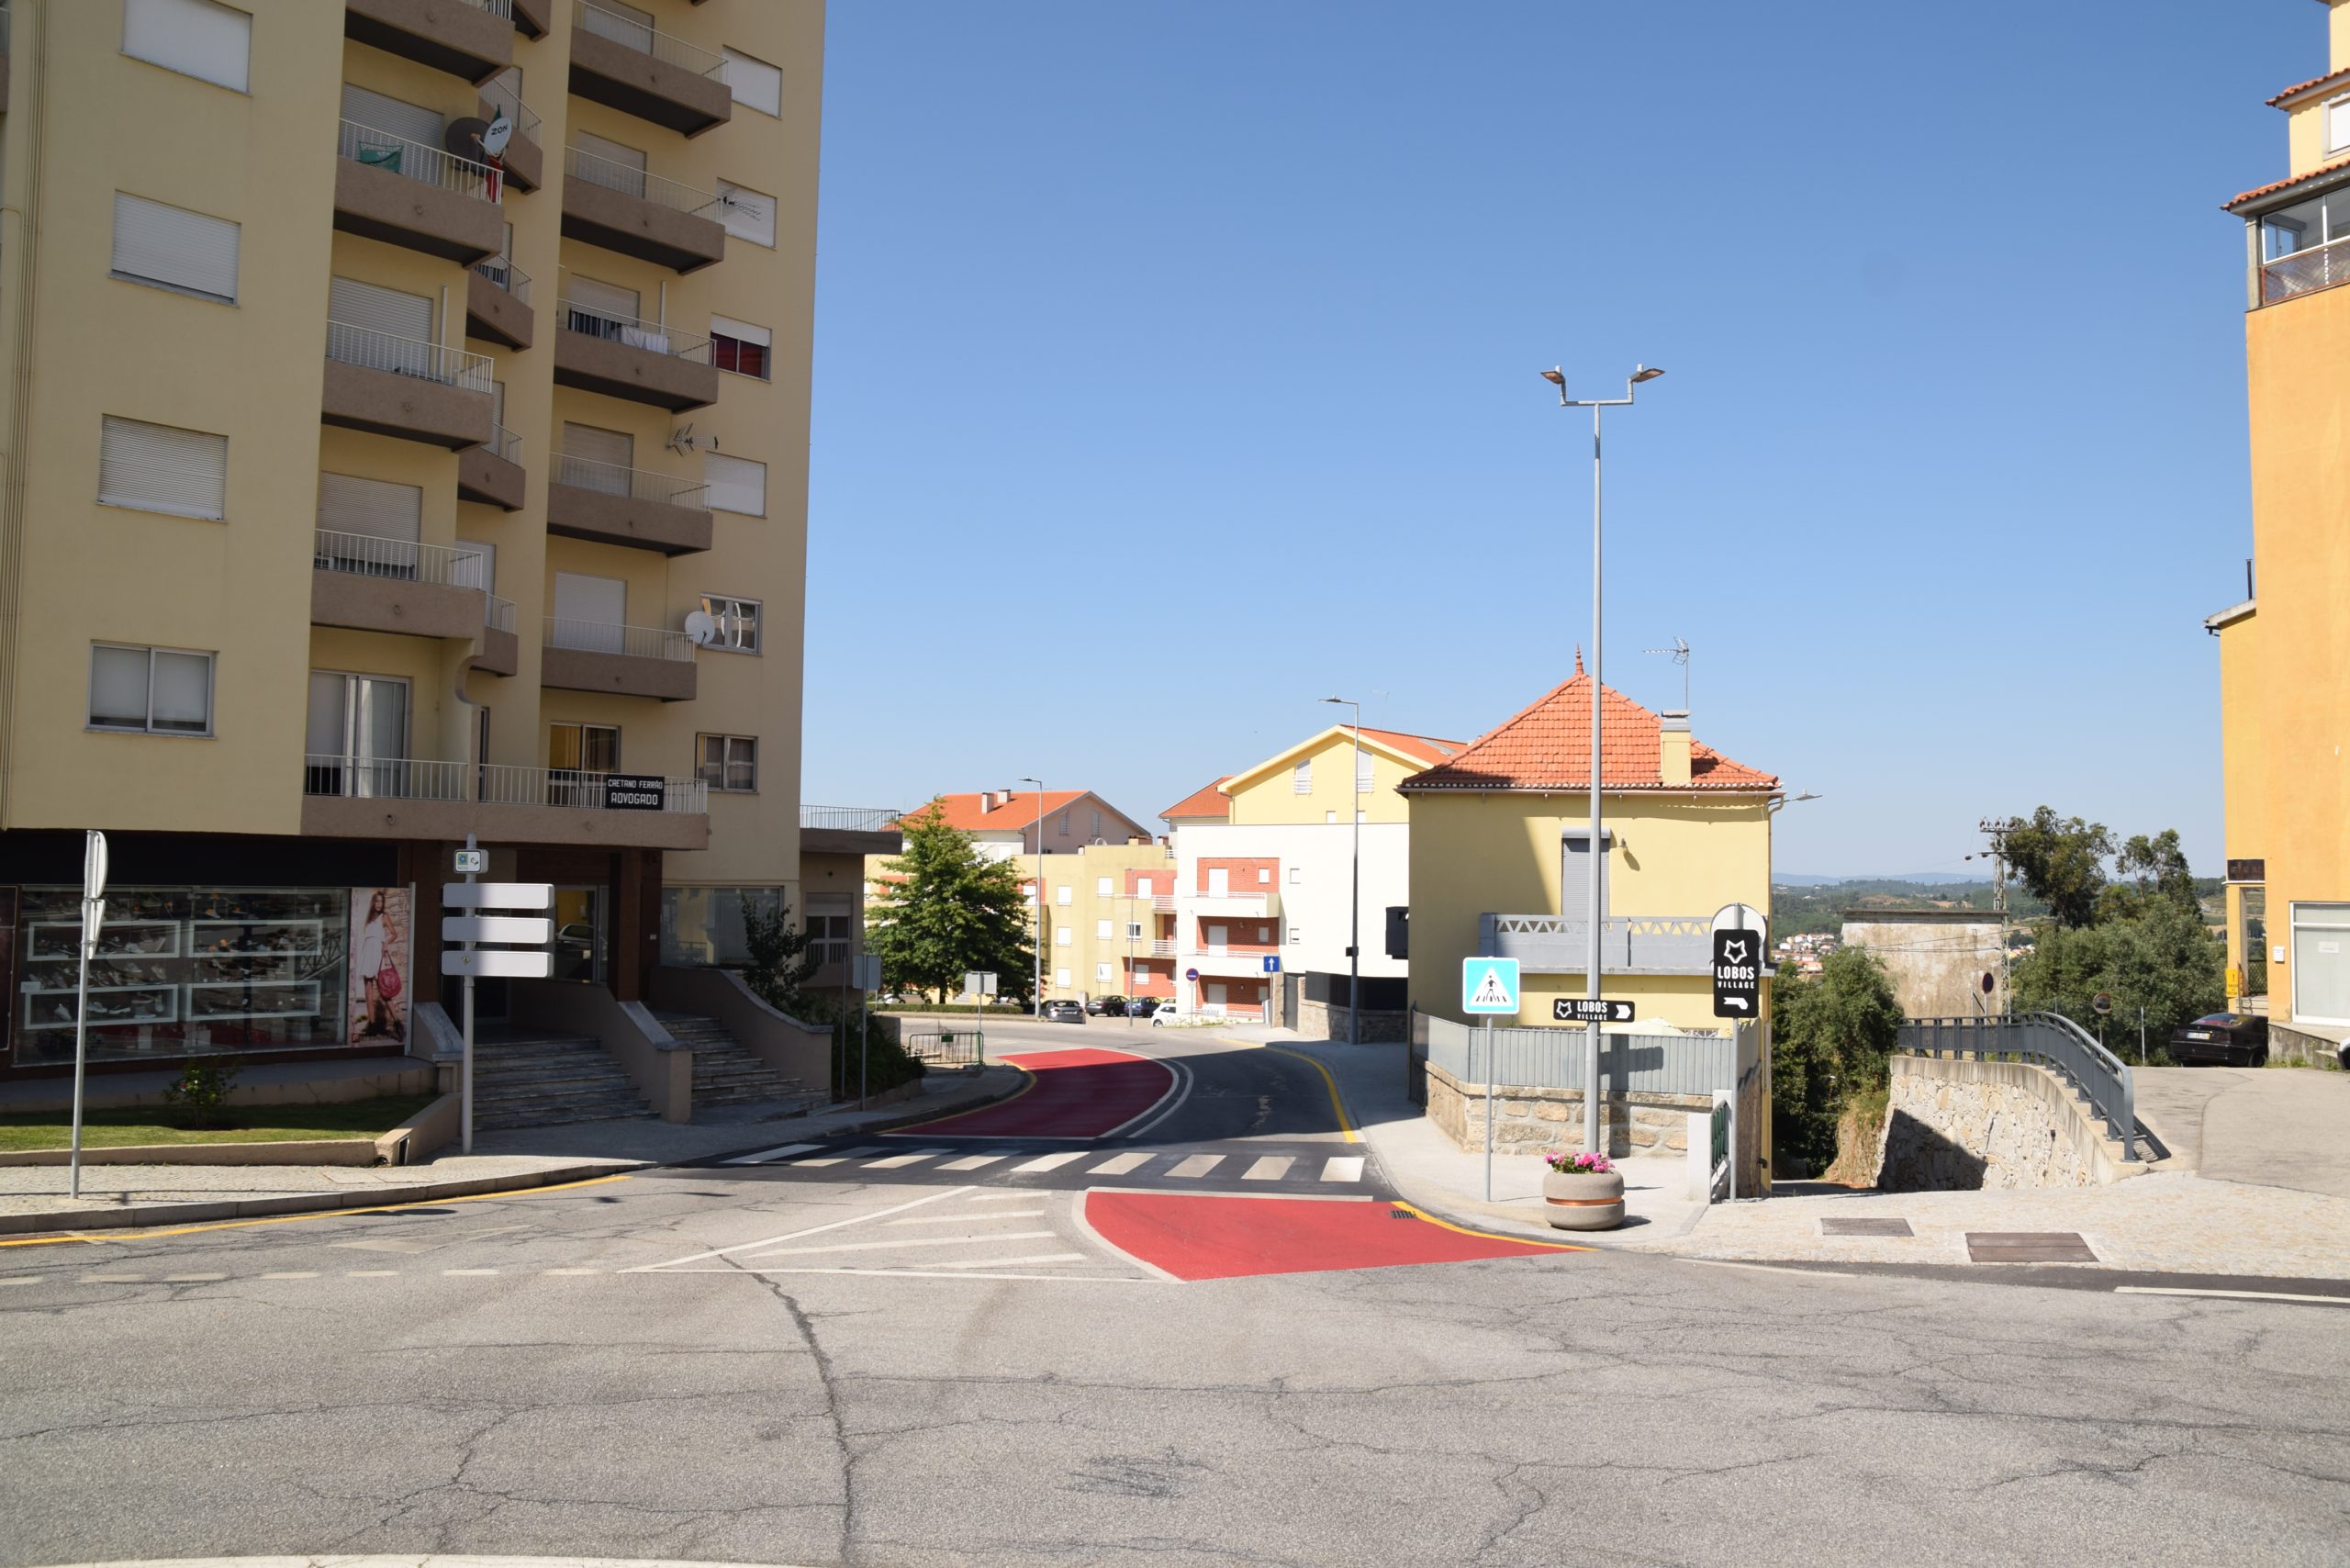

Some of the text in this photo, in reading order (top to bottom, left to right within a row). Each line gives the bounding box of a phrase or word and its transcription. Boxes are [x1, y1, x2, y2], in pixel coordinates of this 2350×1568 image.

[491, 124, 508, 135] ZON
[608, 778, 663, 790] CAETANO FERRÃO
[610, 792, 658, 805] ADVOGADO
[1717, 966, 1755, 980] LOBOS
[1718, 980, 1755, 989] VILLAGE
[1577, 1001, 1608, 1013] LOBOS
